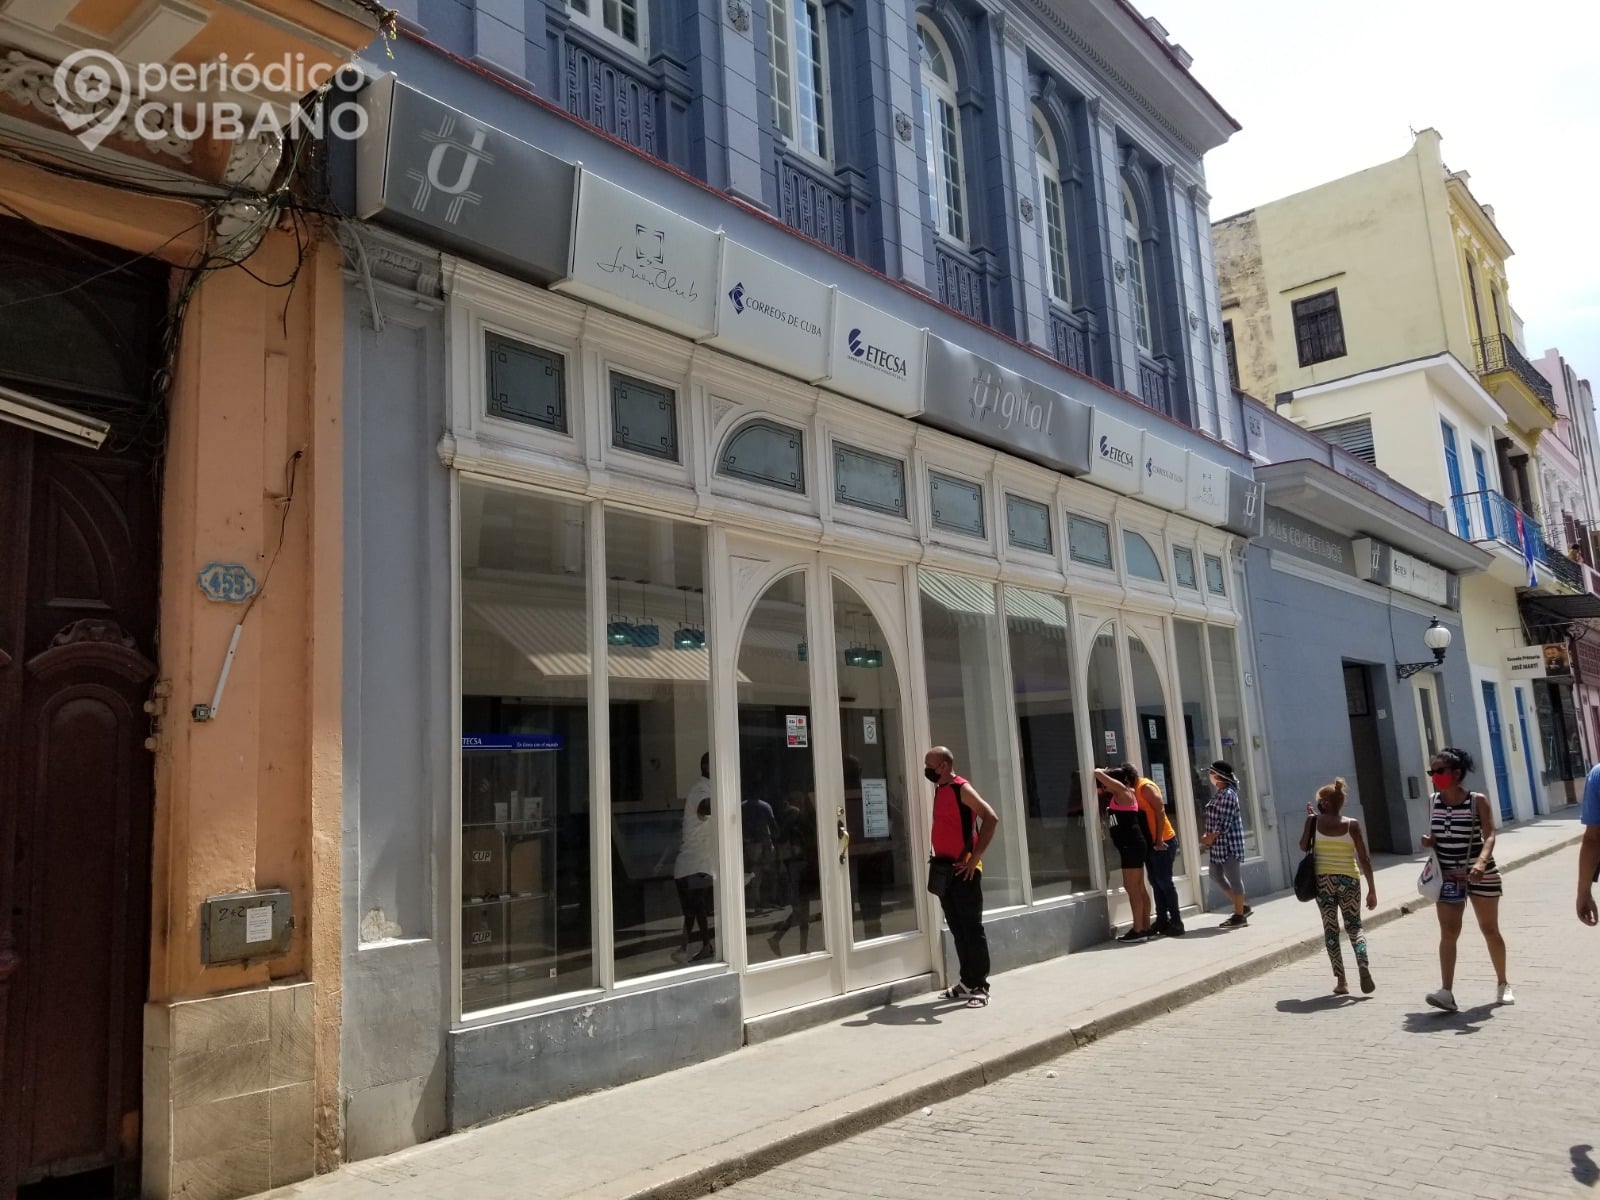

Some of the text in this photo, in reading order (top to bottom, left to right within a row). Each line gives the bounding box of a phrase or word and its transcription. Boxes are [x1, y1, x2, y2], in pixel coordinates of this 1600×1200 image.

[745, 296, 822, 337] CORREOS DE CUBA
[866, 345, 907, 376] ETECSA
[1109, 446, 1134, 468] ETECSA
[209, 572, 246, 595] 455
[462, 737, 482, 745] TECSA
[473, 851, 491, 861] CUP
[472, 932, 490, 944] CUP
